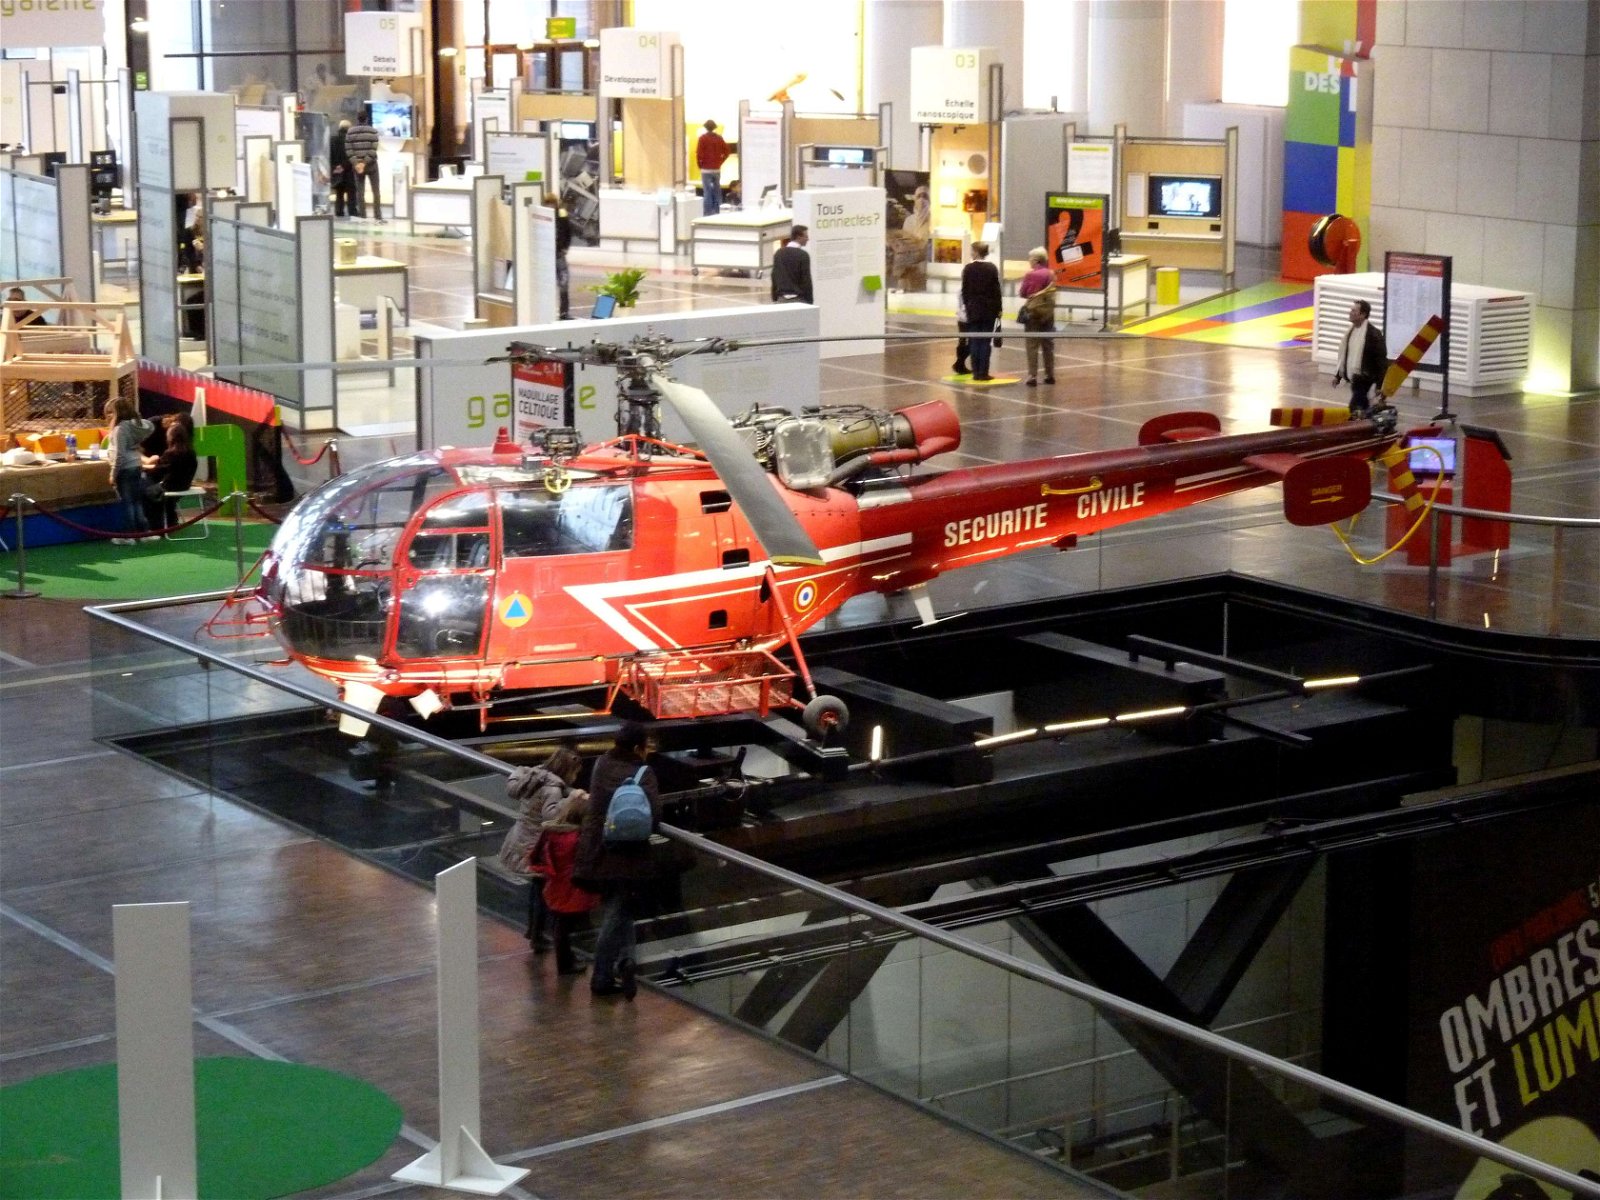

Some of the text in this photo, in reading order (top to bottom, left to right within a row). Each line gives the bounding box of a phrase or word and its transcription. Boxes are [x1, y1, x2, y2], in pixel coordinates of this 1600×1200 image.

[379, 18, 396, 30] 05
[639, 35, 657, 48] 04
[955, 53, 976, 69] 03
[1304, 71, 1341, 95] DES
[629, 87, 657, 95] durable
[944, 99, 975, 108] Echelle
[917, 111, 975, 120] nanoscopique
[817, 203, 844, 216] Tous
[517, 387, 560, 406] MAQUILLAGE
[517, 400, 559, 421] CELTIQUE
[1311, 484, 1343, 497] DANGER
[943, 481, 1146, 548] SECURITE CIVILE
[1439, 919, 1600, 1074] OMBRES
[1454, 1059, 1502, 1138] ET
